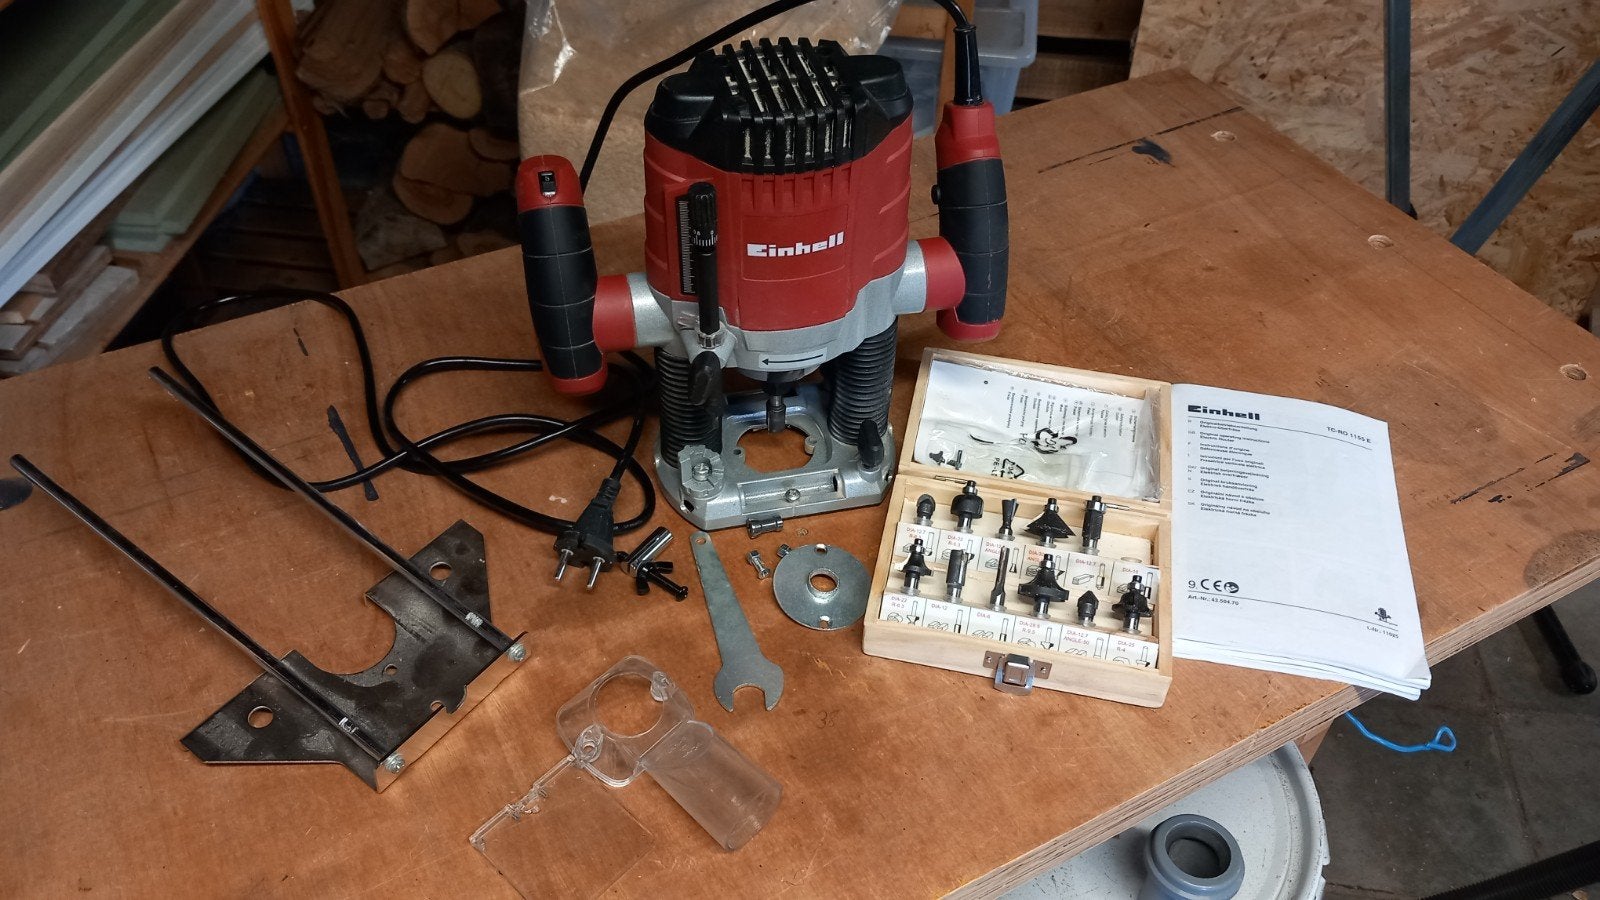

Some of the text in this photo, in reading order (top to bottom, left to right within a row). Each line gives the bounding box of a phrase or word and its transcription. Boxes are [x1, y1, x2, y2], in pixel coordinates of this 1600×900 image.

[747, 231, 844, 257] Einhell
[1187, 404, 1260, 420] Einhell
[1350, 433, 1365, 441] 1155
